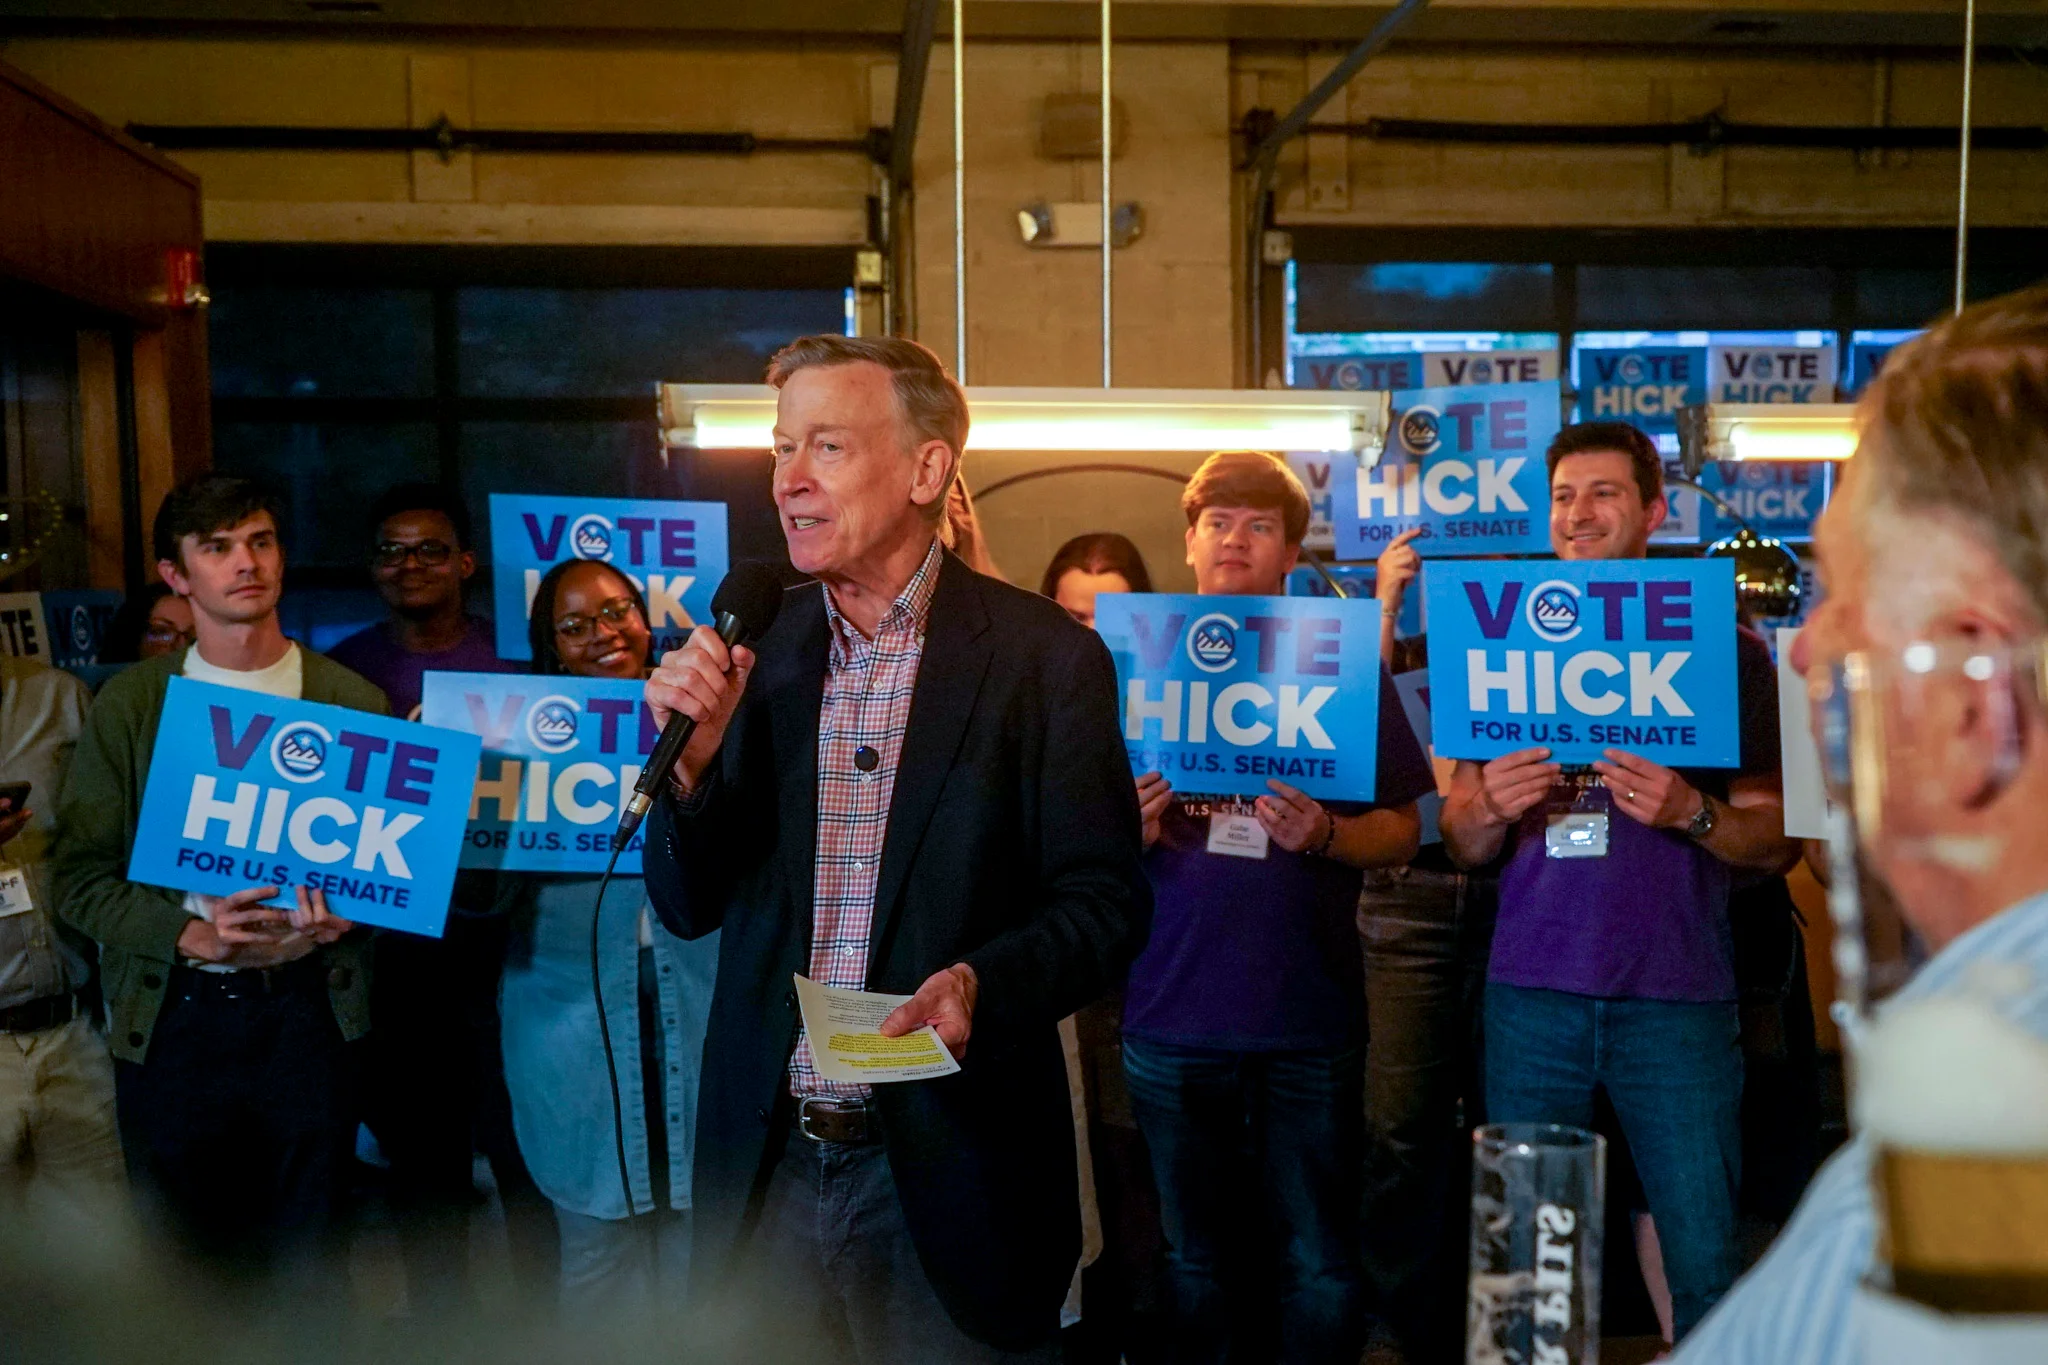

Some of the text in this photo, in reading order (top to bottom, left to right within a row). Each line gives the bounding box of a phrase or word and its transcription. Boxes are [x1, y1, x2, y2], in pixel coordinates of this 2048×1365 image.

[1308, 361, 1409, 389] VOTE
[1441, 357, 1539, 383] VOTE
[1595, 353, 1690, 384] VOTE
[1723, 352, 1819, 381] VOTE
[1593, 384, 1690, 416] HICK
[1399, 400, 1528, 455] OTE
[1356, 456, 1529, 519] HICK
[1715, 488, 1810, 519] HICK
[521, 513, 697, 568] VOTE
[1359, 519, 1531, 543] FOR S. SENATE
[1462, 579, 1693, 643] VOTE
[1130, 612, 1342, 676] VOTE
[1466, 648, 1696, 717] HICK
[1125, 679, 1338, 750] HICK
[1470, 720, 1697, 746] FOR U.S. SENATE
[208, 704, 440, 806] VOTE
[1180, 753, 1226, 773] U.S.
[1234, 754, 1336, 778] SENATE
[182, 774, 425, 880] HICK
[518, 831, 568, 851] U.S.
[176, 847, 411, 910] FOR U.S. SENATE
